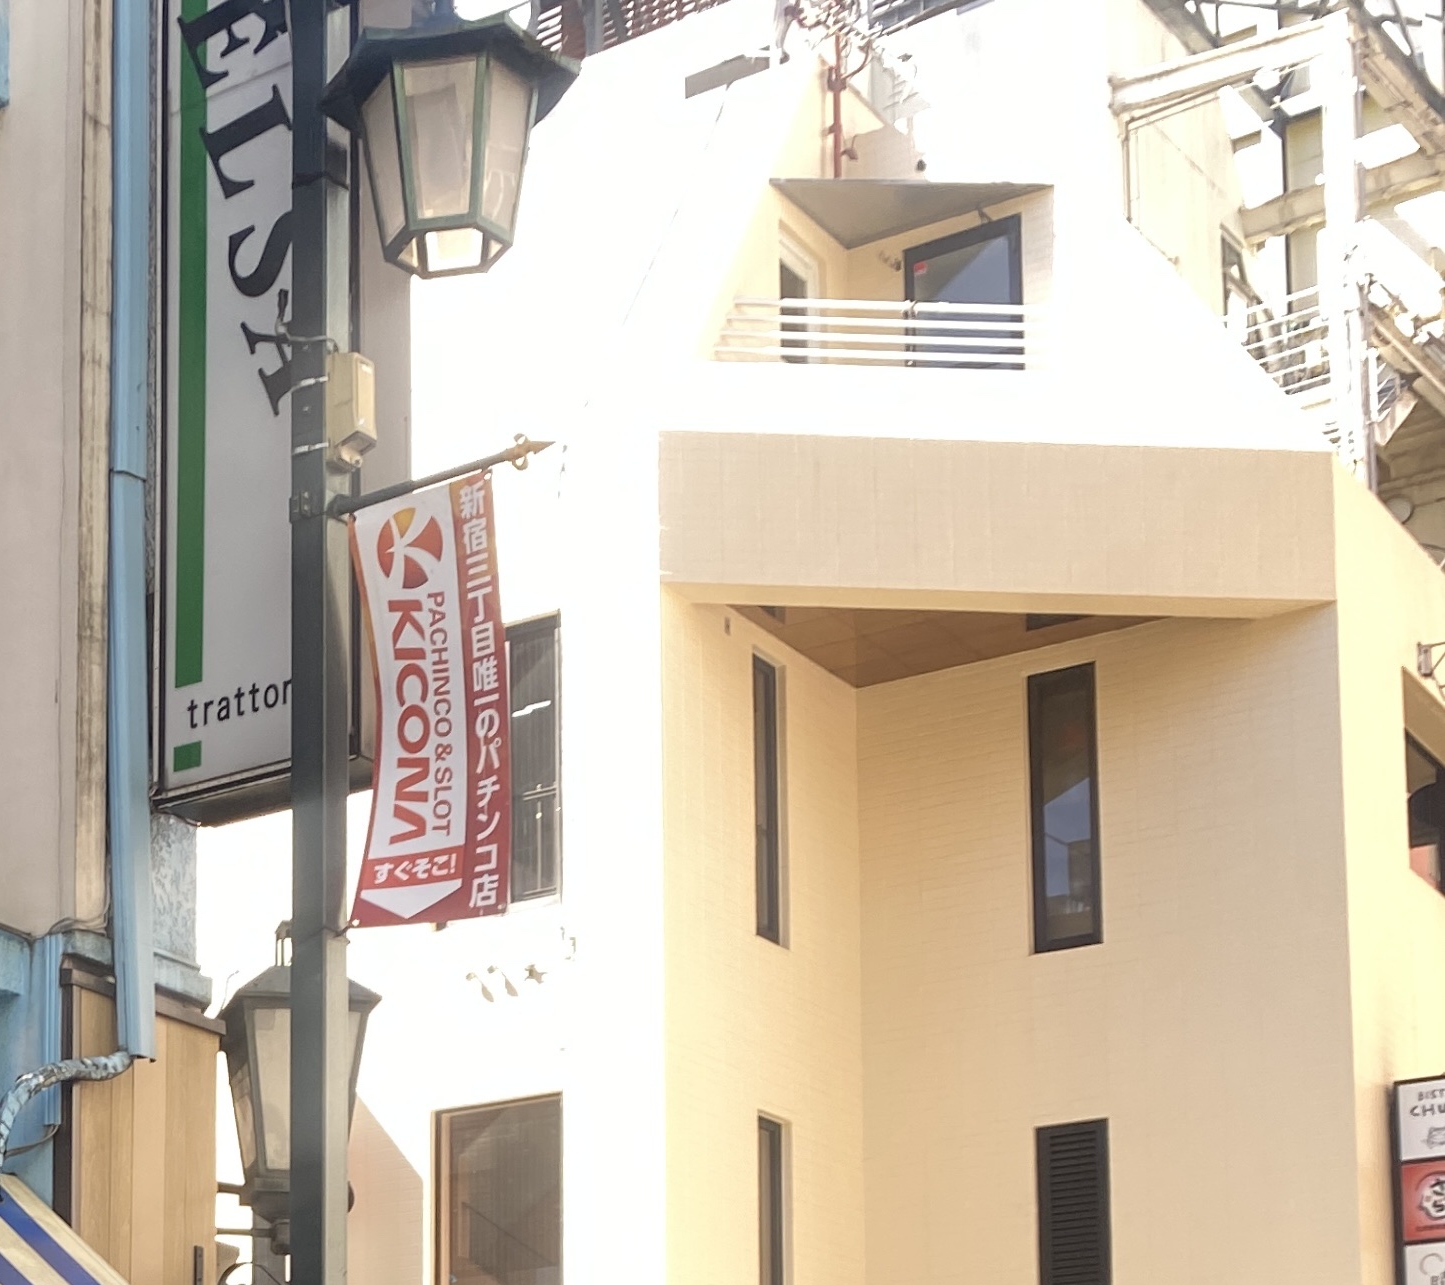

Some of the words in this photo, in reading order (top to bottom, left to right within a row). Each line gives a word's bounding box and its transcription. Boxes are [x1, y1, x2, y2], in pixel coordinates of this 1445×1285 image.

[388, 599, 431, 846] KICONA
[427, 591, 452, 737] PACHINCO
[459, 480, 502, 909] 新宿三丁目唯一のパチンコ店
[432, 767, 453, 836] SLOT
[434, 743, 453, 763] &
